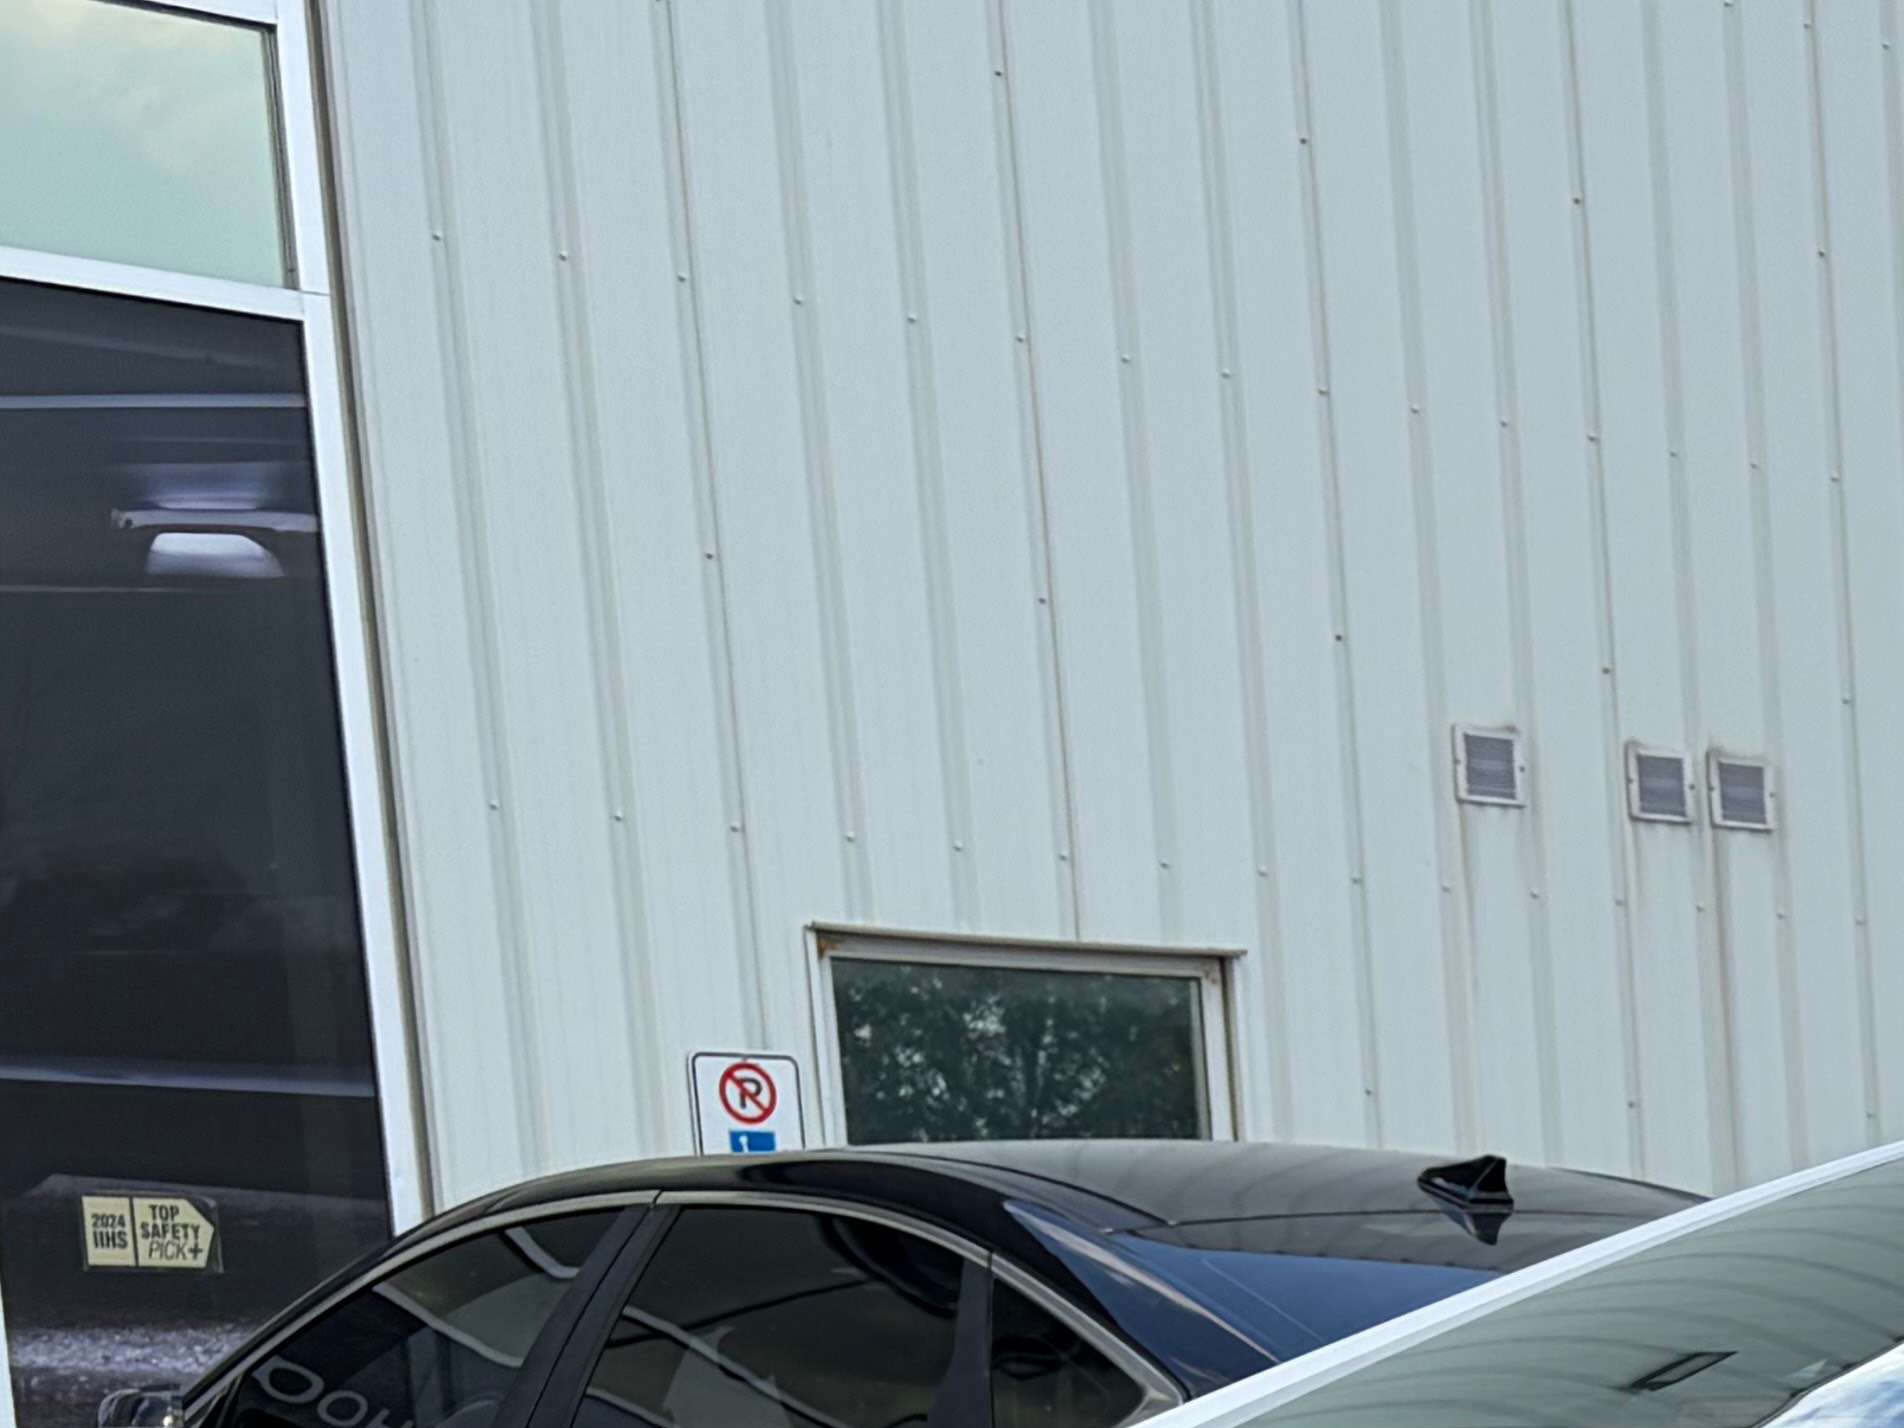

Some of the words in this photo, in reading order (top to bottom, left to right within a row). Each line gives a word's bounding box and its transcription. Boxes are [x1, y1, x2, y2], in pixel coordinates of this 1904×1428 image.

[91, 1213, 126, 1229] 2024
[148, 1204, 180, 1221] TOP
[92, 1230, 128, 1249] IIHS
[140, 1221, 200, 1240] SAFETY
